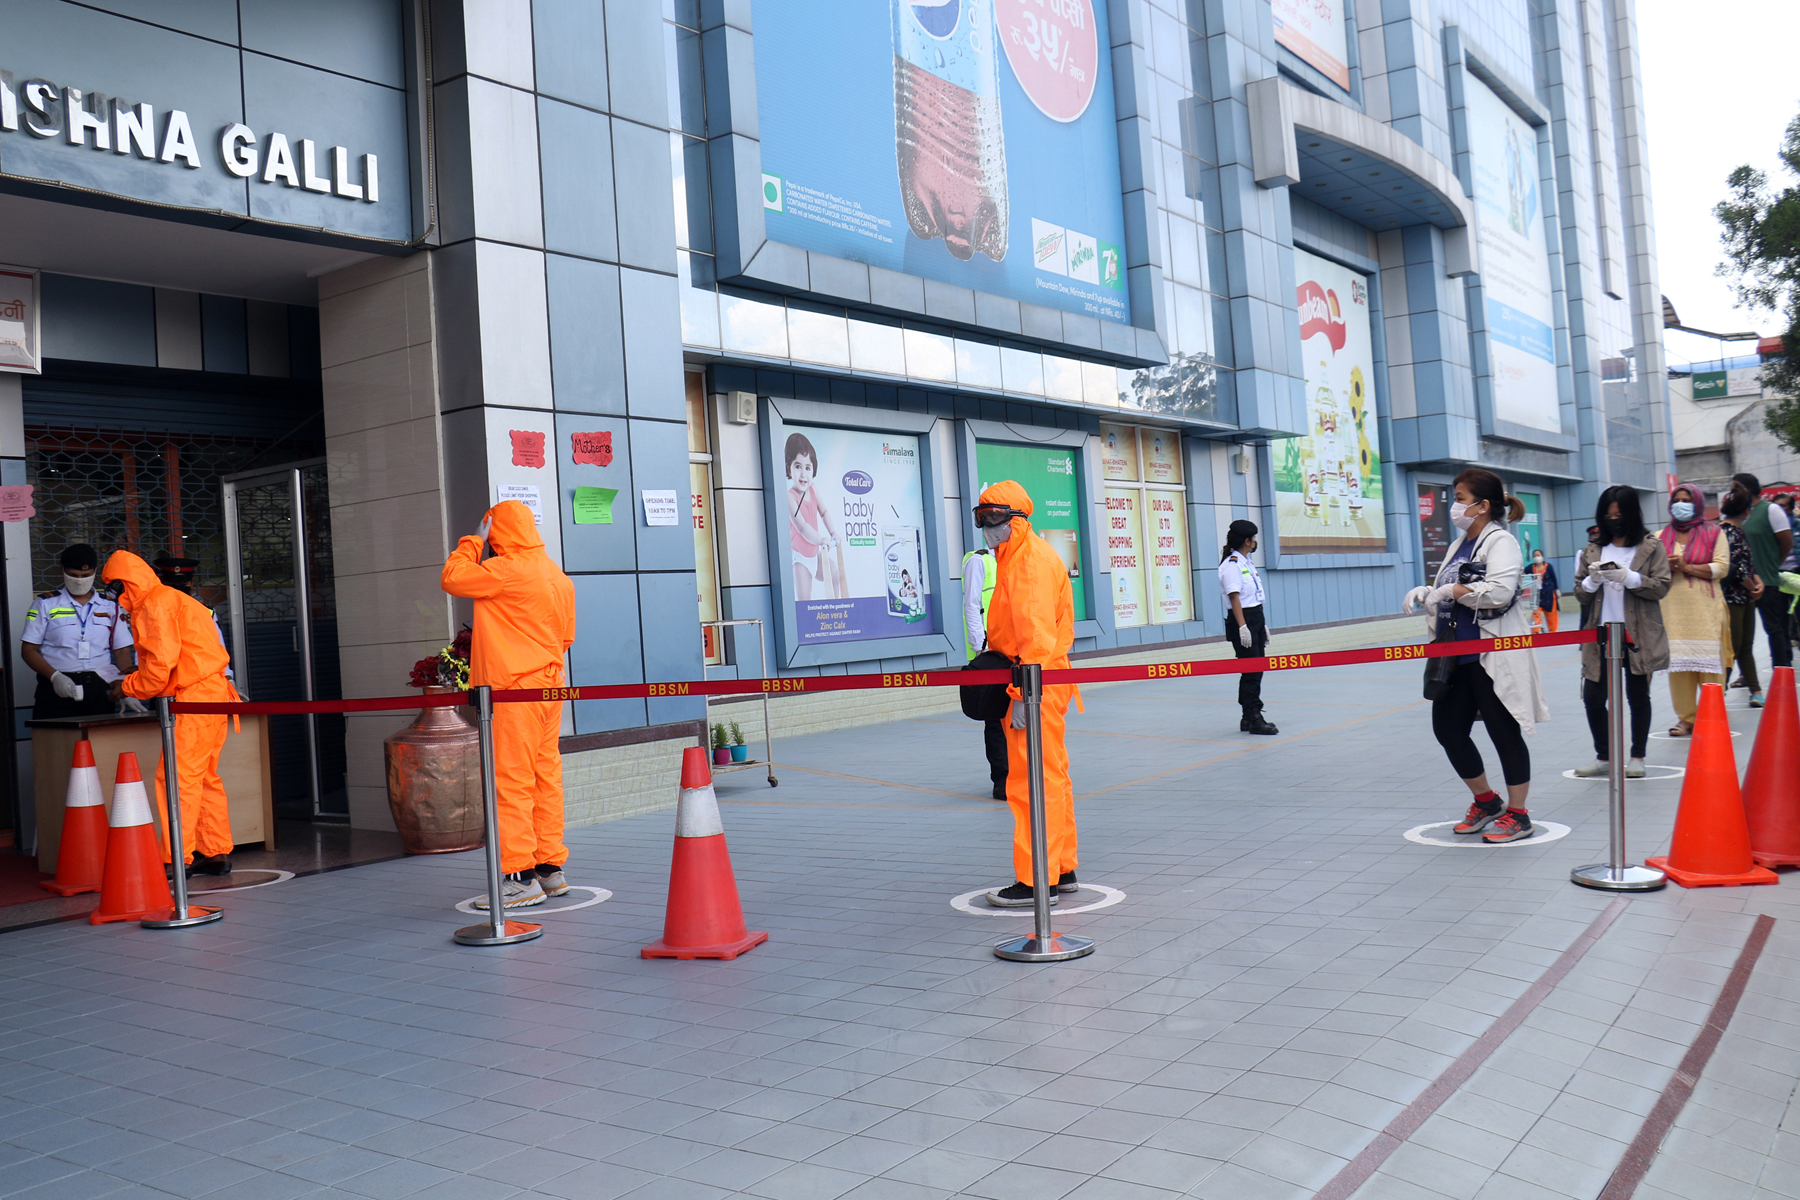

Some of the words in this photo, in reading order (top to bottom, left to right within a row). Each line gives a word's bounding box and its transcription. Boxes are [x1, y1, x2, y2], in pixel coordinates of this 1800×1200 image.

[217, 122, 379, 203] GALLI
[786, 180, 797, 190] Pepsi
[786, 188, 814, 203] CARBONATED
[814, 198, 828, 207] WATER
[852, 208, 878, 222] CARBONATED
[786, 197, 808, 210] CONTAINS
[808, 204, 822, 214] ADDED
[841, 214, 860, 225] CONTAINS
[1036, 277, 1058, 291] (Mountain
[1102, 296, 1120, 308] available
[574, 438, 611, 454] Mother's
[882, 442, 914, 456] Himalaya
[1048, 458, 1065, 466] Standard
[1046, 466, 1066, 474] Chartered
[844, 476, 858, 487] Total
[858, 478, 872, 488] Care
[843, 496, 874, 520] baby
[1126, 498, 1132, 510] TO
[1152, 500, 1162, 511] OUR
[1162, 500, 1174, 512] GOAL
[1112, 516, 1126, 530] GREAT
[1159, 518, 1164, 530] IS
[1164, 518, 1170, 530] TO
[845, 518, 878, 542] pants
[1108, 536, 1132, 548] SHOPPING
[1158, 536, 1174, 548] SATISFY
[1154, 554, 1180, 566] CUSTOMERS
[888, 562, 900, 572] baby
[834, 602, 850, 610] goodness
[844, 610, 848, 618] &
[820, 622, 832, 630] Zinc
[1495, 637, 1532, 650] BBSM
[1384, 646, 1425, 660] BBSM
[1269, 654, 1312, 670] BBSM
[1148, 664, 1192, 678] BBSM
[762, 679, 805, 692] BBSM
[883, 674, 928, 687] BBSM
[542, 688, 581, 700] BBSM
[649, 684, 690, 696] BBSM
